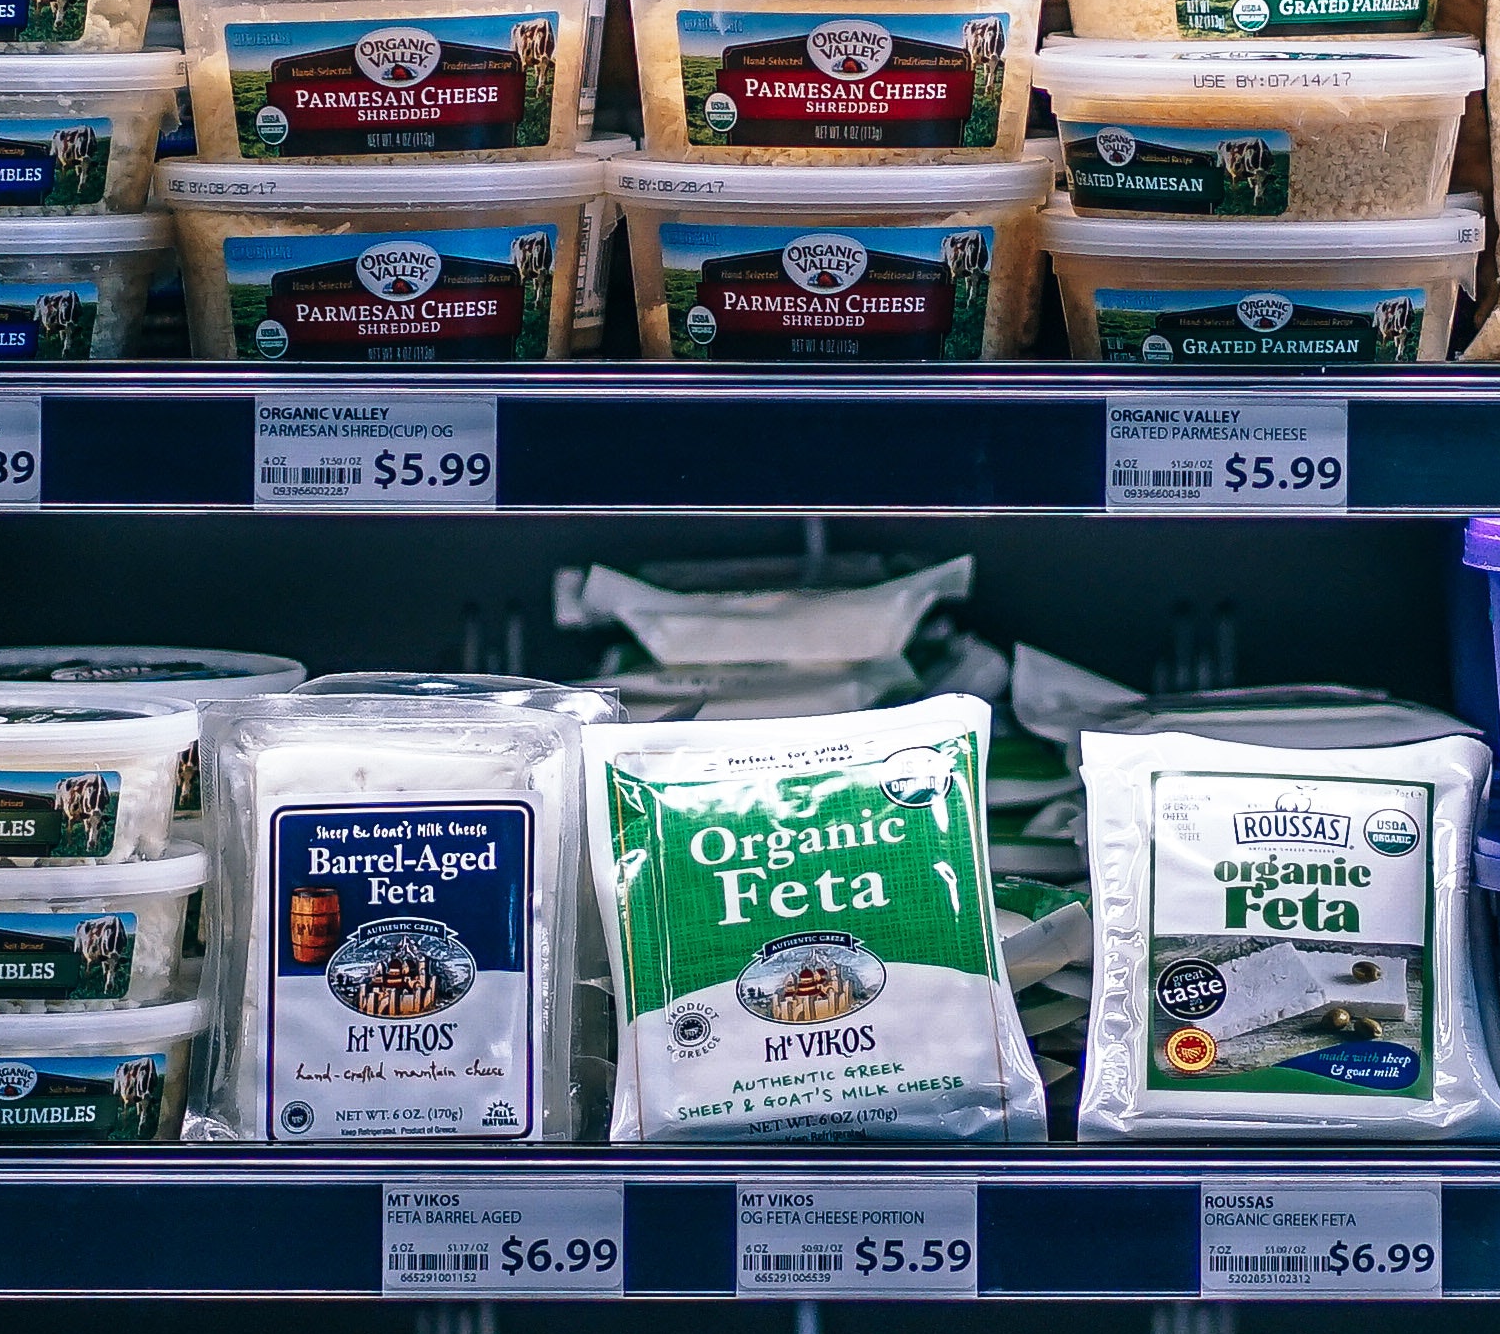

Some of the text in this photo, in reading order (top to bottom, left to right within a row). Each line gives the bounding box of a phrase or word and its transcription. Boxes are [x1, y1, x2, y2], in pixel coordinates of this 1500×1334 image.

[1193, 71, 1352, 89] USE BY:07/14/17
[295, 86, 499, 108] PARMESAN CHEESE
[357, 107, 441, 122] SHREDDED
[690, 808, 906, 870] Organic
[1244, 814, 1341, 841] ROUSSAS
[307, 841, 497, 880] Barrel-Aged
[1213, 853, 1372, 893] organic
[367, 877, 435, 905] Feta
[714, 866, 891, 926] Feta
[1224, 881, 1361, 934] Feta
[732, 1062, 905, 1094] AUTHENTIC GREEK
[387, 1193, 460, 1207] MT VIKOS
[501, 1234, 618, 1277] $6.99
